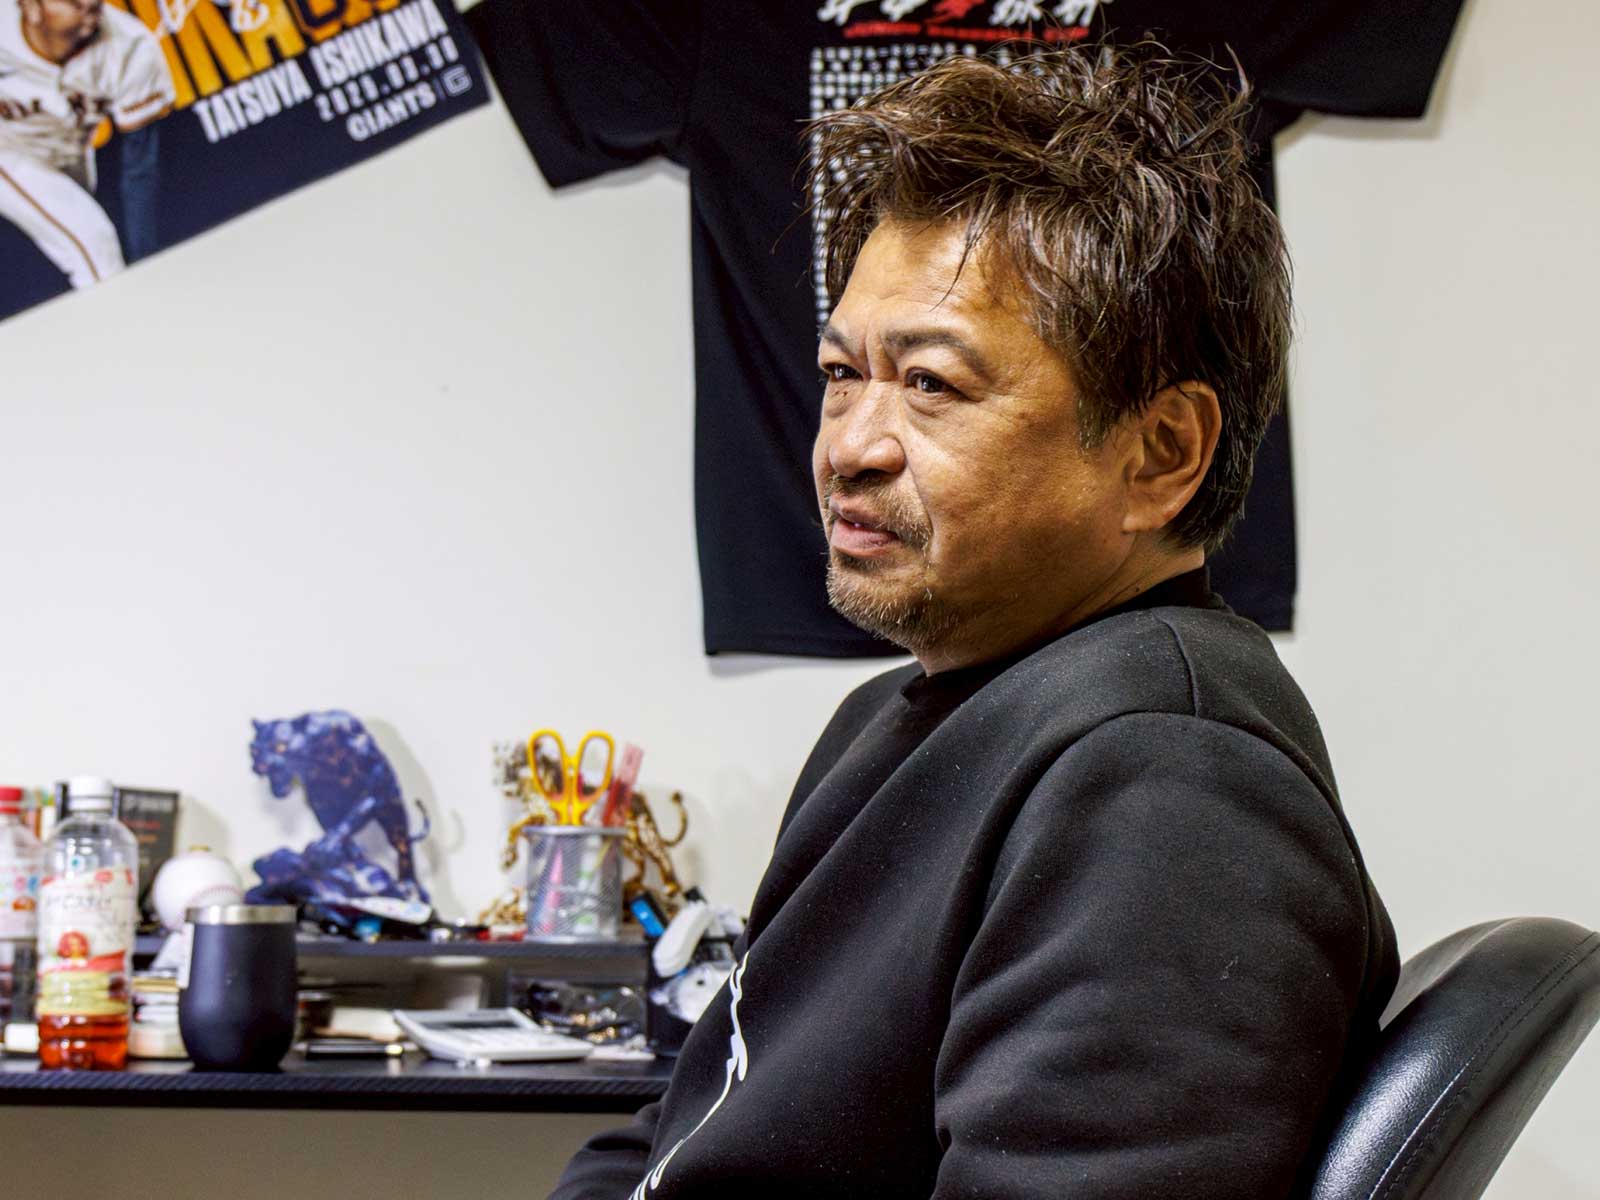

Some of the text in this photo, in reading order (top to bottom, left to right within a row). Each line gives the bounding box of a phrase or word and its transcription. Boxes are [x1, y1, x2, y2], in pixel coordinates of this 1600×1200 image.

[192, 58, 313, 143] TATSUYA
[309, 0, 448, 88] ISHIKAWA
[346, 81, 437, 141] GIANTS
